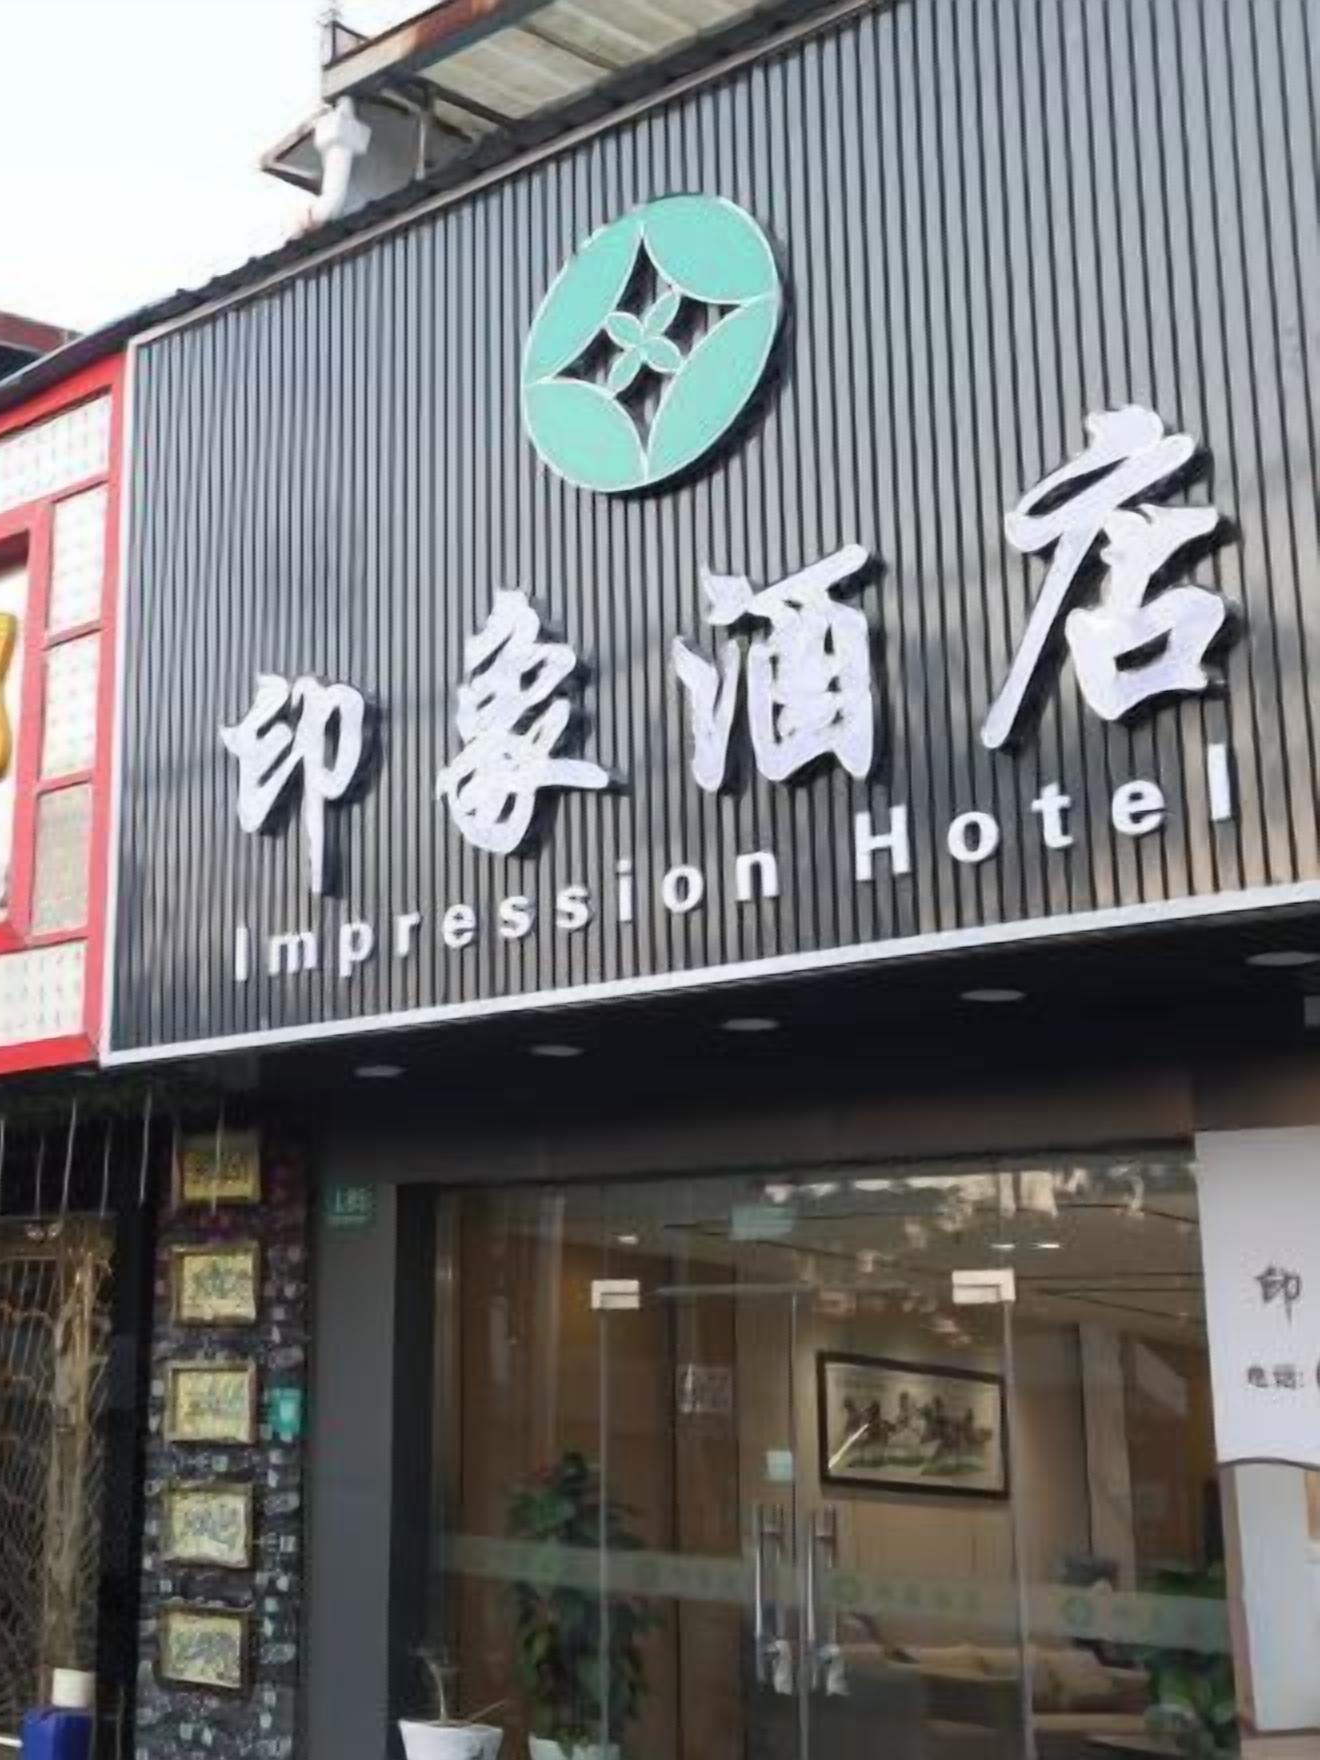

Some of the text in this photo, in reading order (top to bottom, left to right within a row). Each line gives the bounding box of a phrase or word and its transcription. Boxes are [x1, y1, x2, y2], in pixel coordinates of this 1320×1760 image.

[222, 404, 1226, 893] 印象酒店
[234, 744, 1235, 982] Impression Hotel
